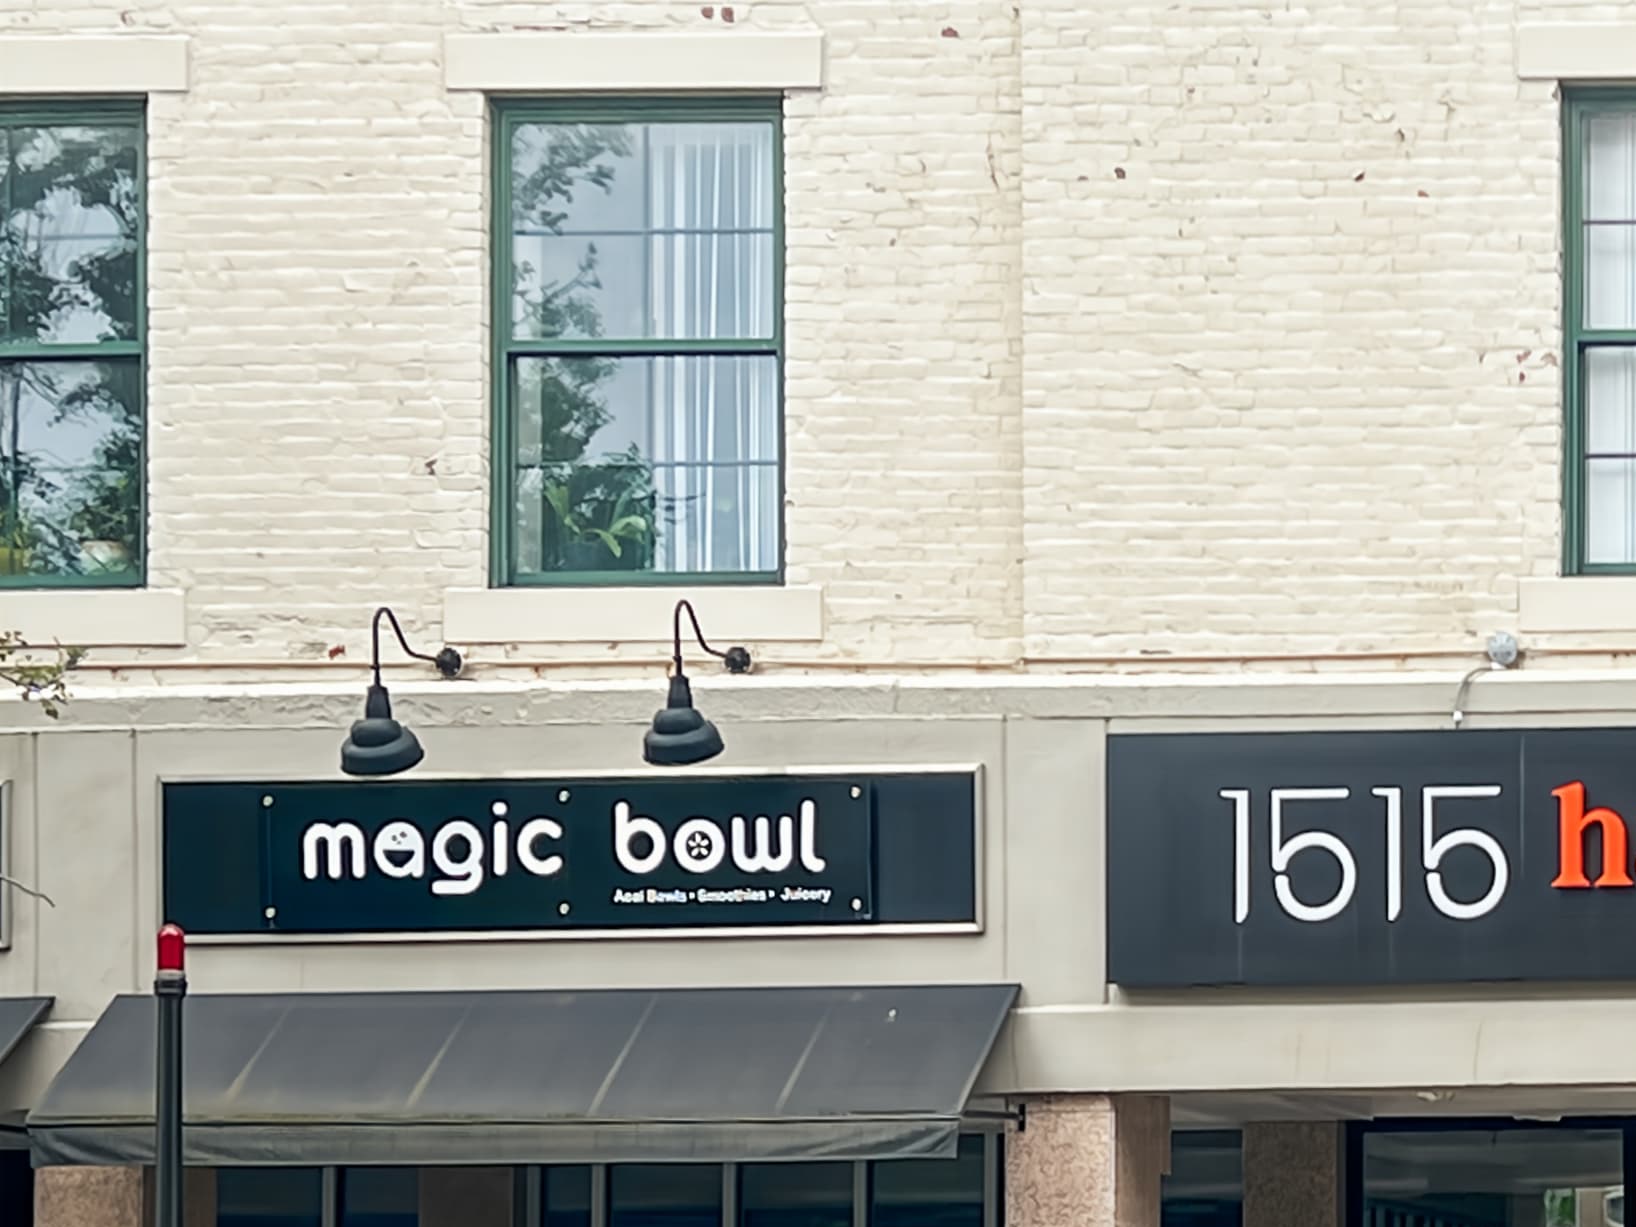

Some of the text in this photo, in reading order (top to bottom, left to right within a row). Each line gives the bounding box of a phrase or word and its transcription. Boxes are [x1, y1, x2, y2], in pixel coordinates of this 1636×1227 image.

[303, 799, 827, 895] magic bowl
[1220, 785, 1510, 924] 1515
